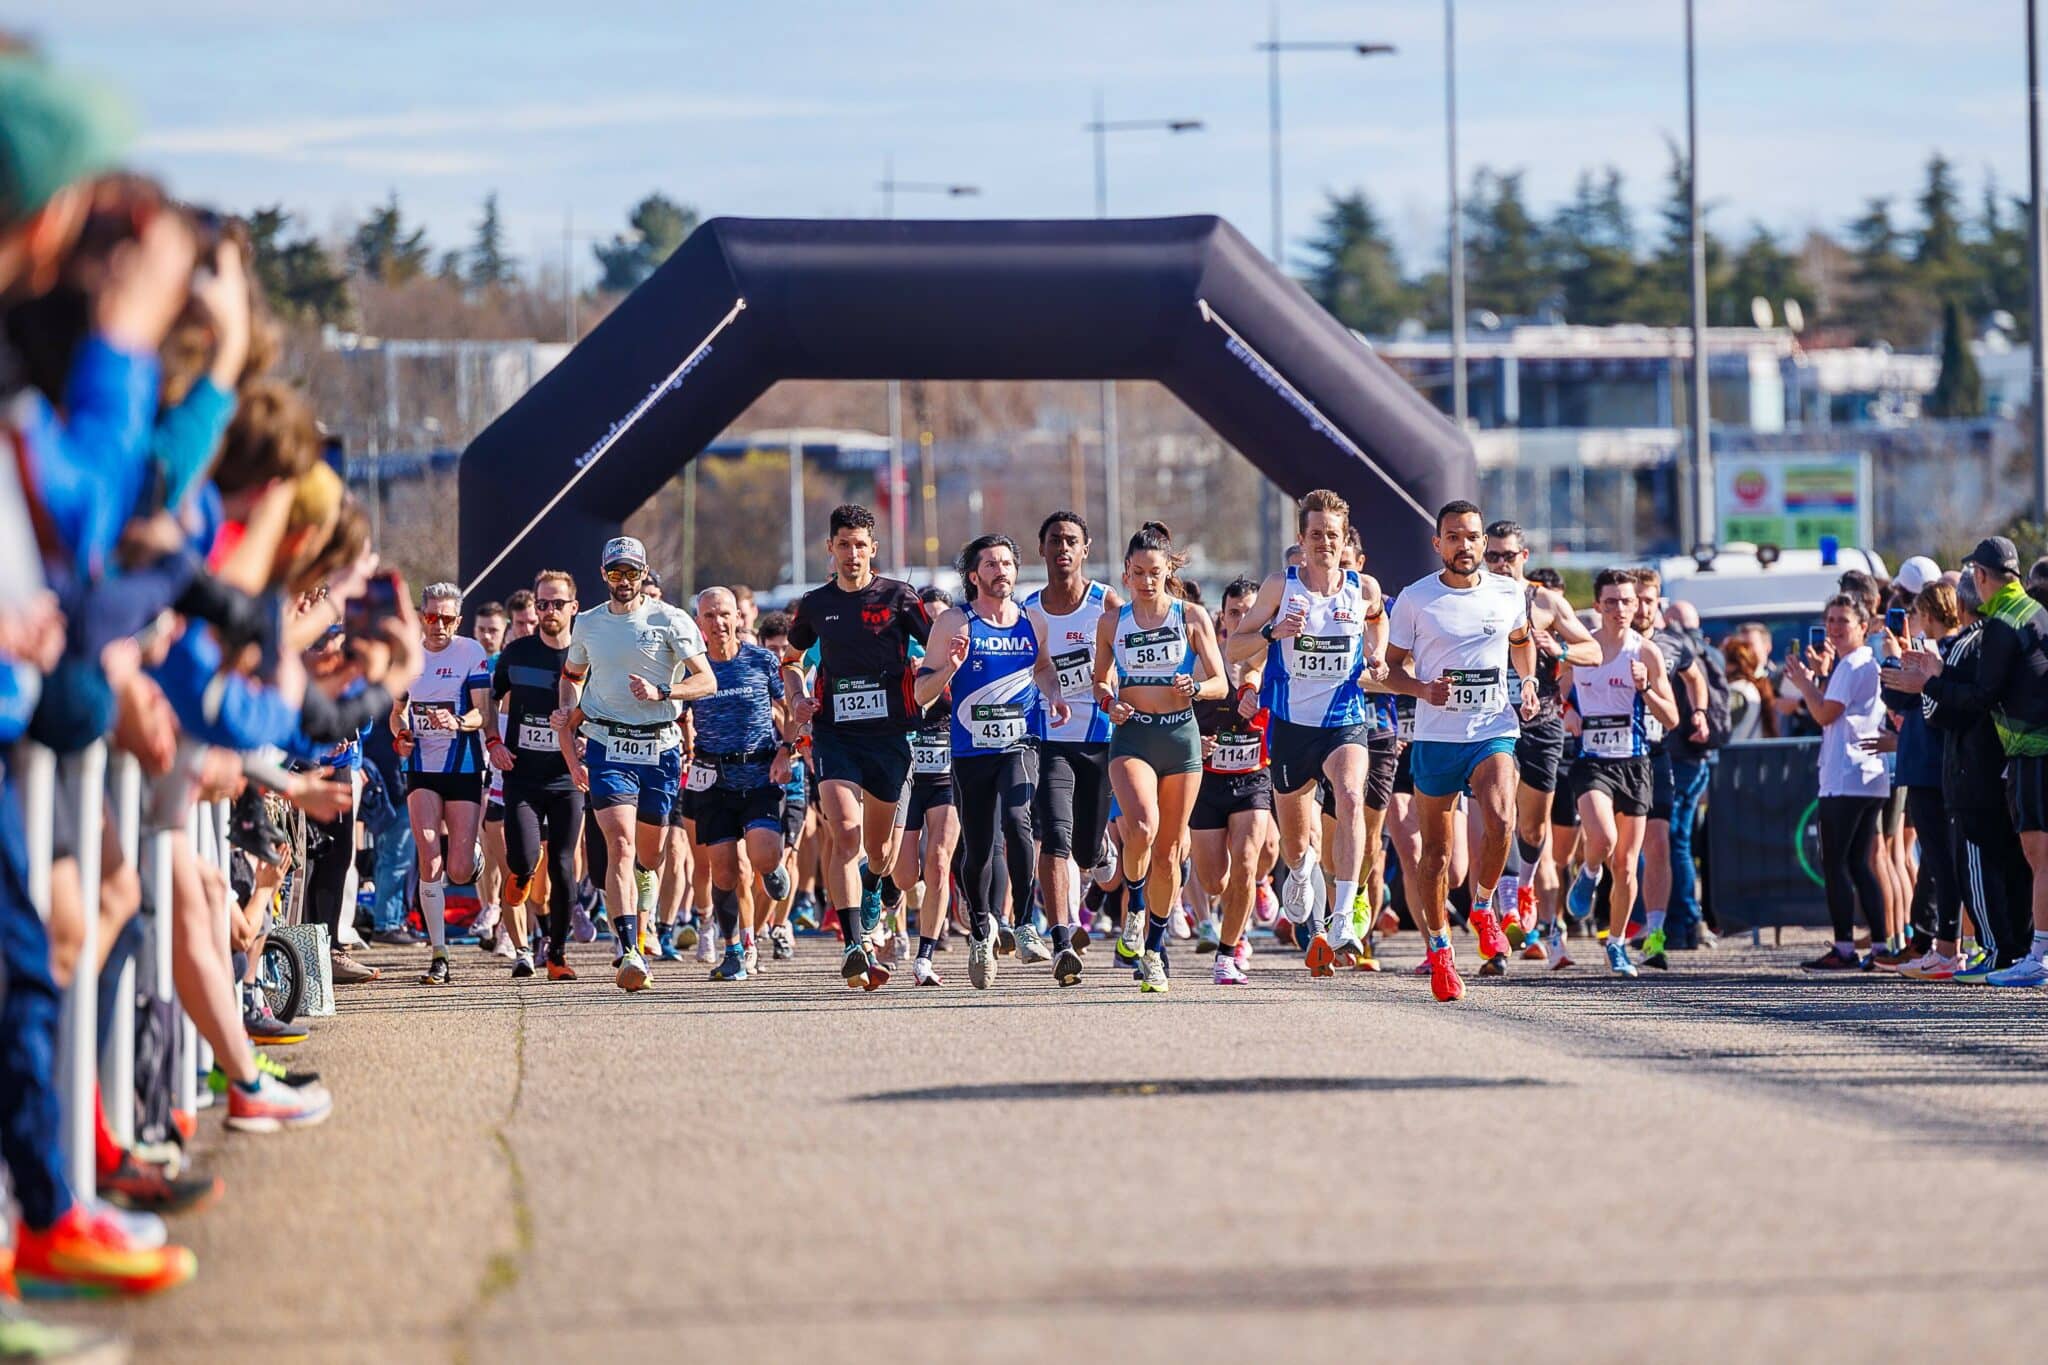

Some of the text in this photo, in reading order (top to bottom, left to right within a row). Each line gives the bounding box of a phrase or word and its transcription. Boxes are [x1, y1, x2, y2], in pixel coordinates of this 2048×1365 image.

[1334, 611, 1352, 619] ESL
[1066, 632, 1084, 640] ESL
[989, 637, 1033, 650] DMA
[1137, 646, 1169, 663] 58.1
[1299, 655, 1341, 671] 131.1
[840, 694, 878, 711] 132.1
[1454, 689, 1487, 703] 19.1
[1130, 710, 1193, 725] RO NIKE
[527, 729, 553, 743] 12.1
[983, 723, 1014, 738] 43.1
[1592, 730, 1620, 744] 47.1
[614, 740, 652, 756] 140.1
[1219, 748, 1255, 762] 114.1
[917, 750, 946, 763] 33.1
